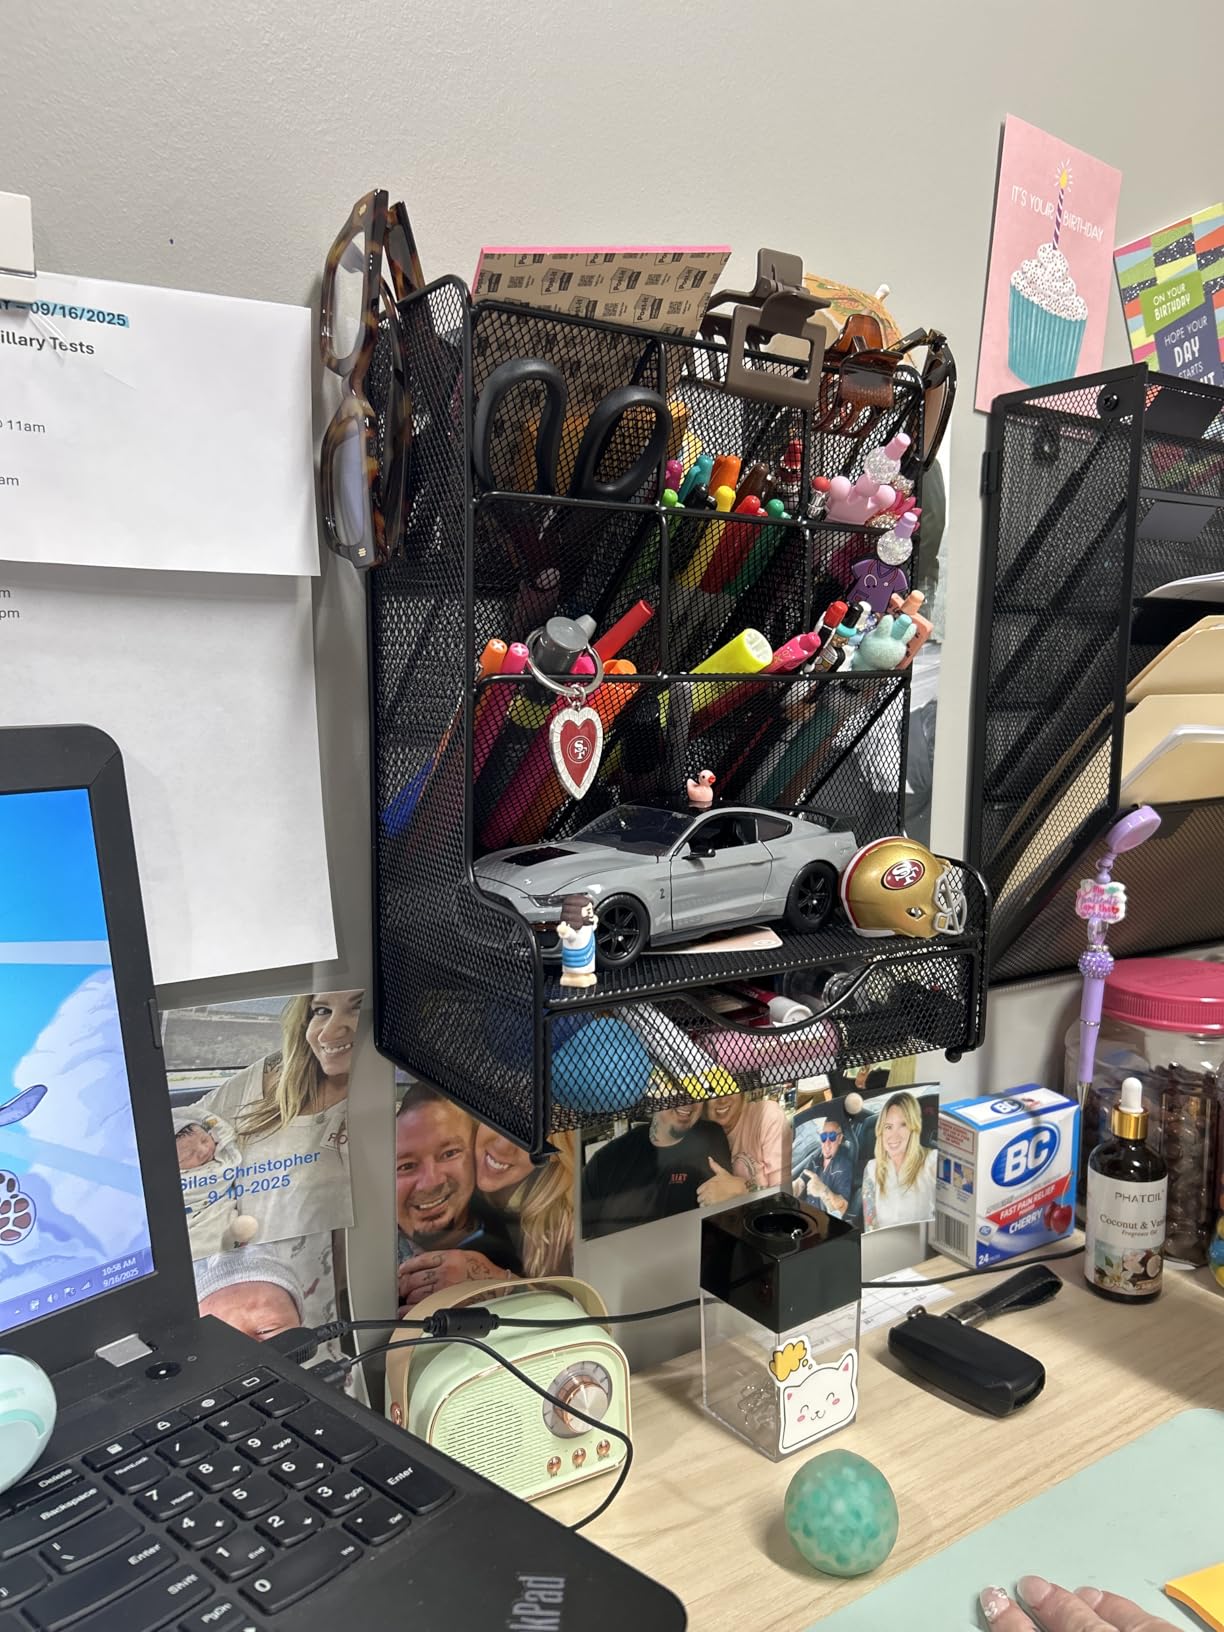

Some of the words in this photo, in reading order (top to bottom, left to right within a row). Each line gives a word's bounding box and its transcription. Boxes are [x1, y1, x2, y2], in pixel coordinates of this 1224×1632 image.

[1011, 184, 1028, 207] IT'S
[1030, 193, 1056, 220] YOUR
[1062, 209, 1104, 243] BIRTHDAY
[1153, 294, 1165, 306] ON
[1167, 283, 1186, 298] YOUR
[30, 301, 127, 328] 09/16/2025
[1154, 293, 1191, 321] BIRTHDAY
[1164, 327, 1186, 346] HOPE
[1186, 315, 1208, 334] YOUR
[49, 336, 95, 355] Tests
[1174, 336, 1200, 367] DAY
[1179, 362, 1204, 379] STARTS
[8, 419, 46, 433] 11am
[892, 860, 920, 886] SF
[993, 1100, 1019, 1113] BC
[1003, 1130, 1051, 1183] BC
[223, 1151, 321, 1182] Christopher
[207, 1174, 291, 1205] 9-10-2025
[1115, 1192, 1162, 1203] PHATOIL
[1000, 1205, 1019, 1220] FAST
[1017, 1197, 1033, 1211] PAIN
[1033, 1184, 1056, 1201] RELIEF
[1009, 1207, 1044, 1234] CHERRY
[1100, 1214, 1138, 1230] Coconut
[1140, 1221, 1148, 1230] &
[978, 1253, 989, 1265] 24
[248, 1438, 261, 1448] 9
[199, 1463, 213, 1474] 8
[281, 1461, 296, 1472] 6
[38, 1468, 72, 1488] Delete
[386, 1467, 414, 1486] Enter
[145, 1490, 158, 1501] 7
[232, 1488, 248, 1500] 5
[317, 1486, 333, 1497] 3
[40, 1488, 98, 1520] Backspace
[182, 1517, 195, 1528] 4
[267, 1515, 285, 1528] 2
[128, 1544, 161, 1565] Enter
[216, 1547, 230, 1558] 1
[167, 1574, 199, 1595] Shift
[254, 1579, 272, 1592] 0
[201, 1603, 232, 1624] PgDn
